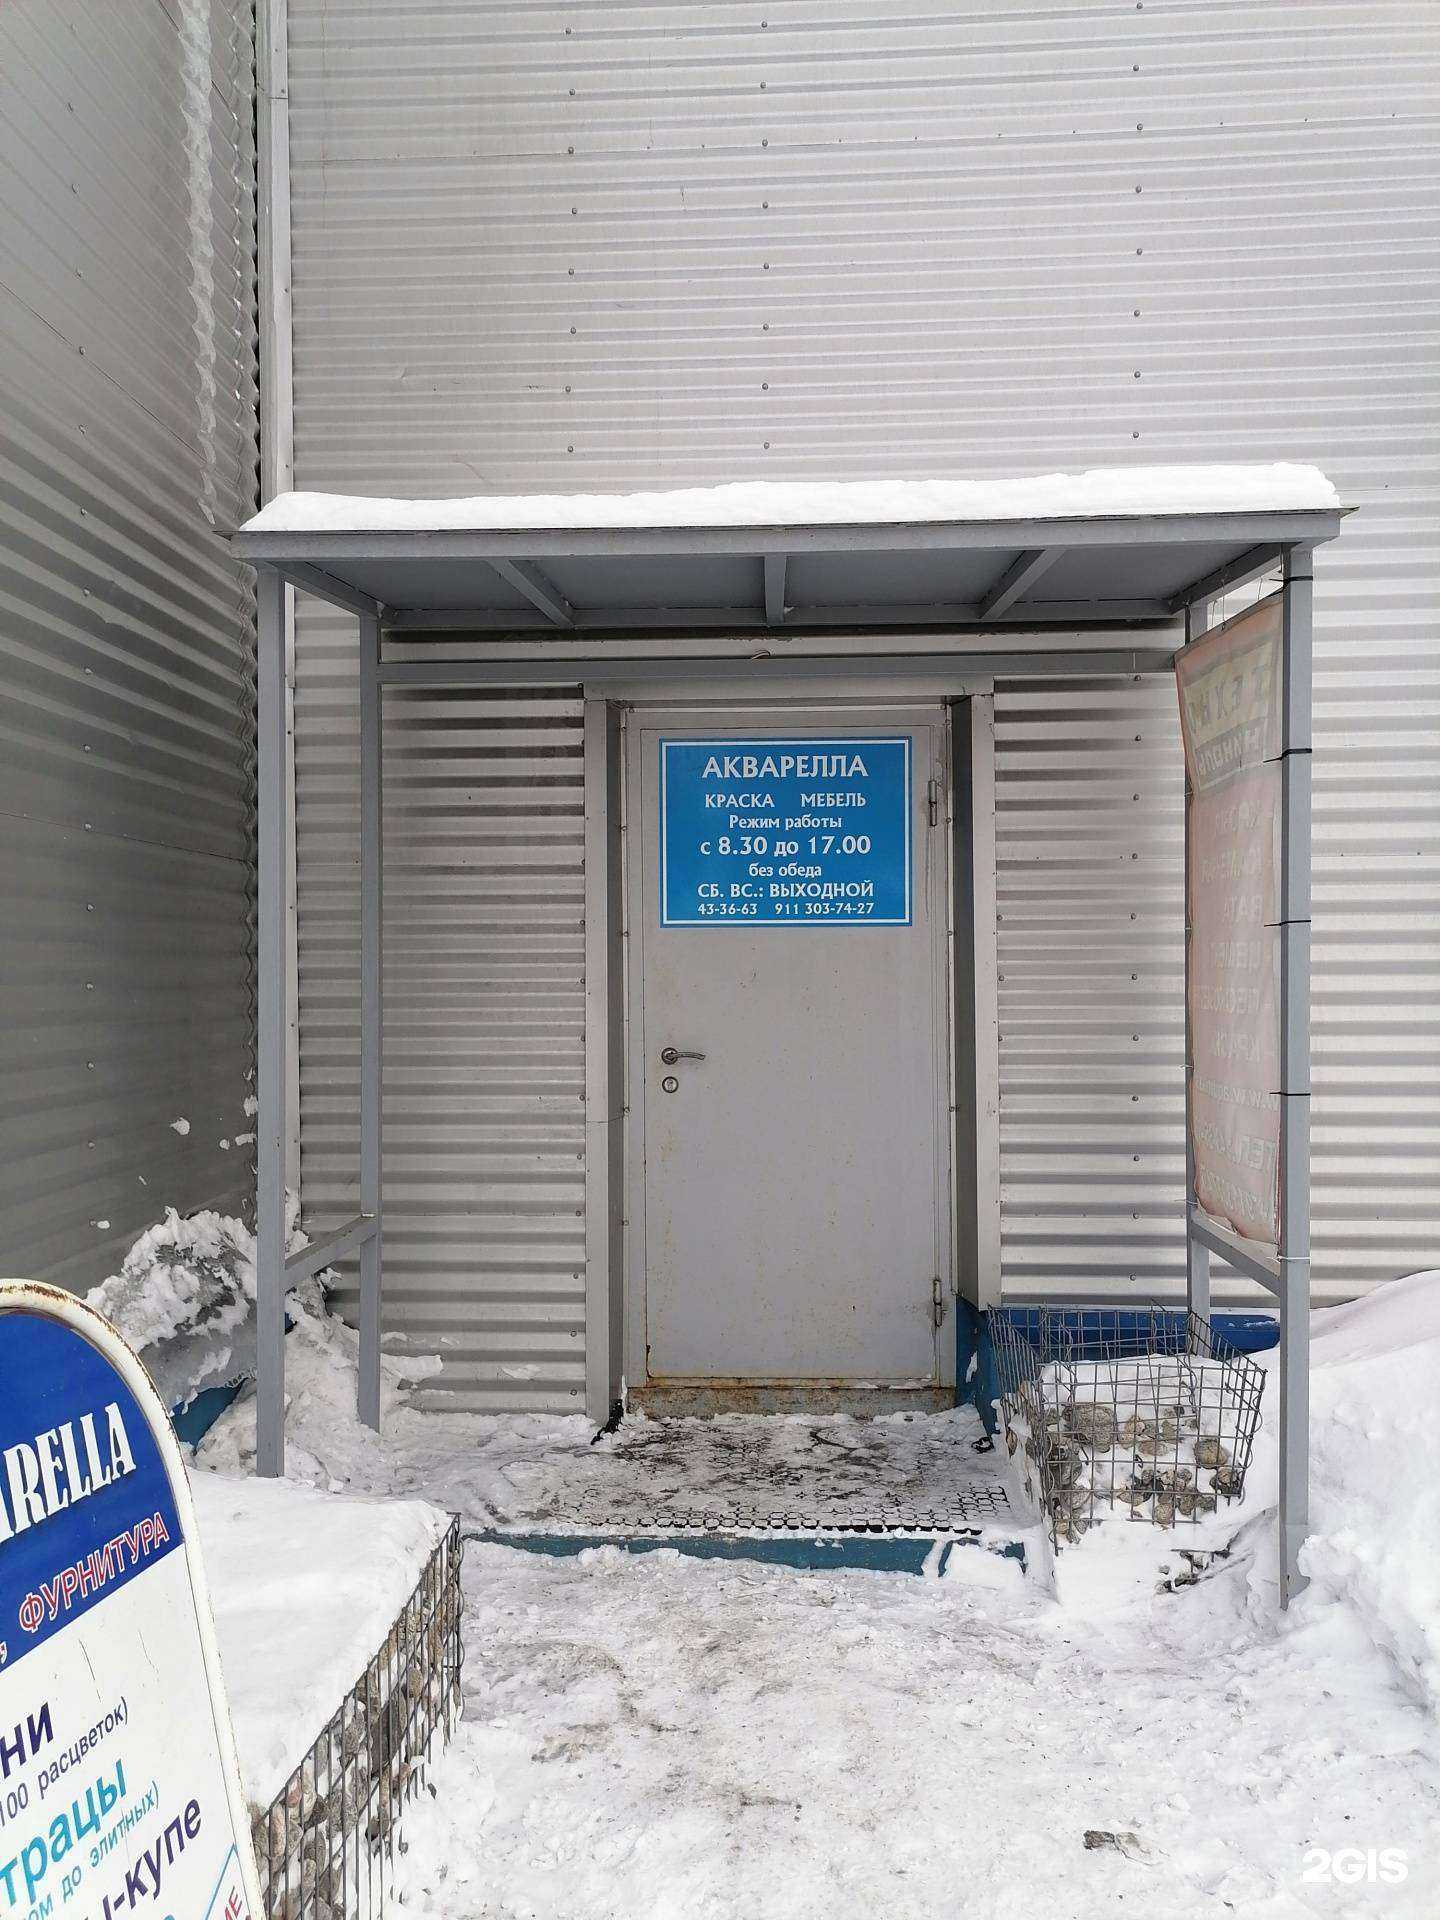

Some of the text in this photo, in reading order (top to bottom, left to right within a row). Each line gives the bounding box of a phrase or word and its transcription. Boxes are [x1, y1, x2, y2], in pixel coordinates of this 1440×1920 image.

[702, 755, 869, 778] АКВАРЕЛЛА
[705, 792, 866, 808] КРАСКА МЕБЕЛЬ
[729, 813, 842, 831] Режим работы
[700, 835, 871, 857] с 8.30 до 17.00
[749, 863, 822, 878] без обеда
[698, 880, 874, 899] СБ. ВС.: ВЫХОДНОЙ
[697, 902, 874, 915] 43-36-63 911 303-74-27
[19, 1511, 170, 1633] ФУРНИТУРА
[37, 1696, 128, 1800] расцветок)
[62, 1866, 82, 1903] до
[89, 1780, 159, 1868] элитных)
